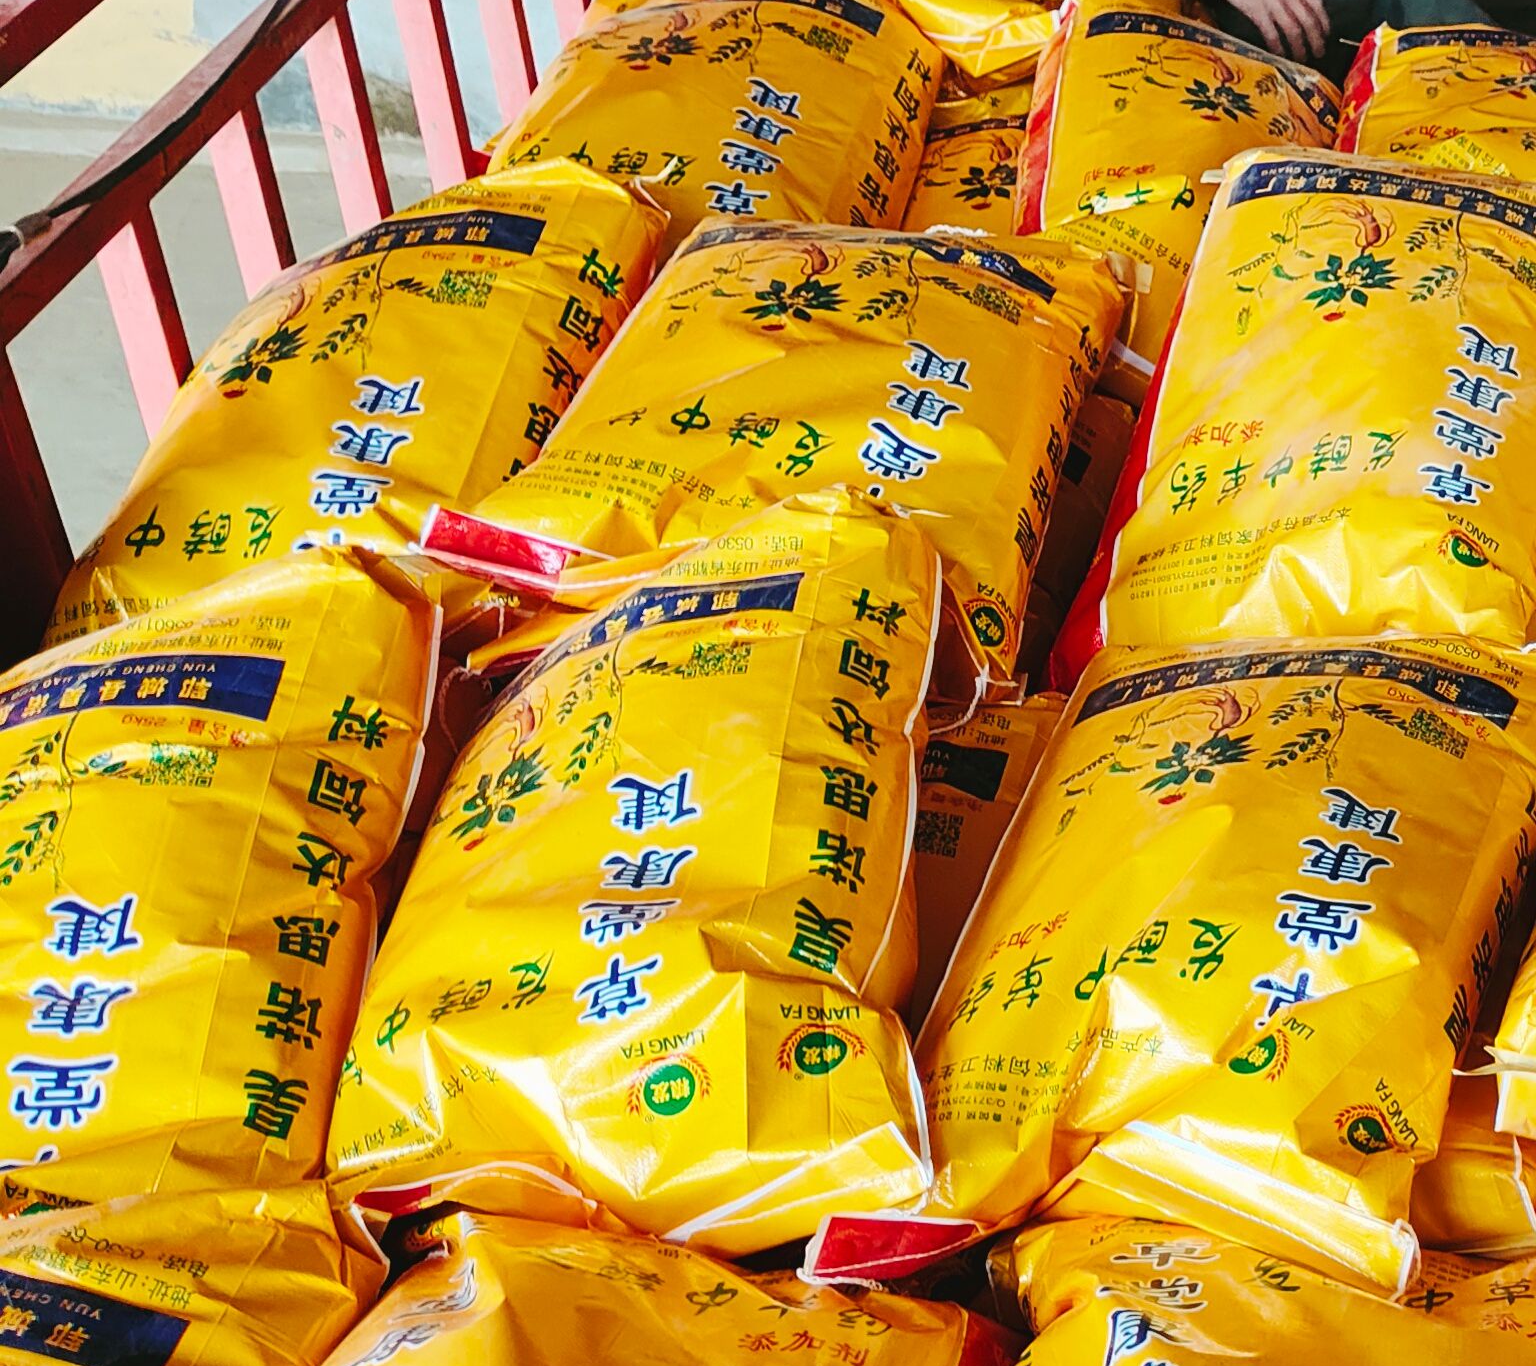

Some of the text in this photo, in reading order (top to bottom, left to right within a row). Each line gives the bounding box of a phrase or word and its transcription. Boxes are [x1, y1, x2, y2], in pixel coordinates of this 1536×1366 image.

[704, 77, 802, 216] 草堂康健
[292, 376, 424, 547] 堂康健
[856, 339, 970, 483] 堂康健
[1168, 429, 1409, 514] 发酵中草药
[1182, 418, 1265, 449] 添加剂
[1418, 322, 1522, 508] 草堂康健
[787, 587, 908, 975] 昊诺思达饲料
[242, 694, 390, 1139] 昊诺思达饲料
[576, 768, 699, 1025] 草堂康健
[0, 894, 141, 1151] 堂康健
[619, 1027, 706, 1061] LIANG FA
[779, 1003, 862, 1024] LIANG FA
